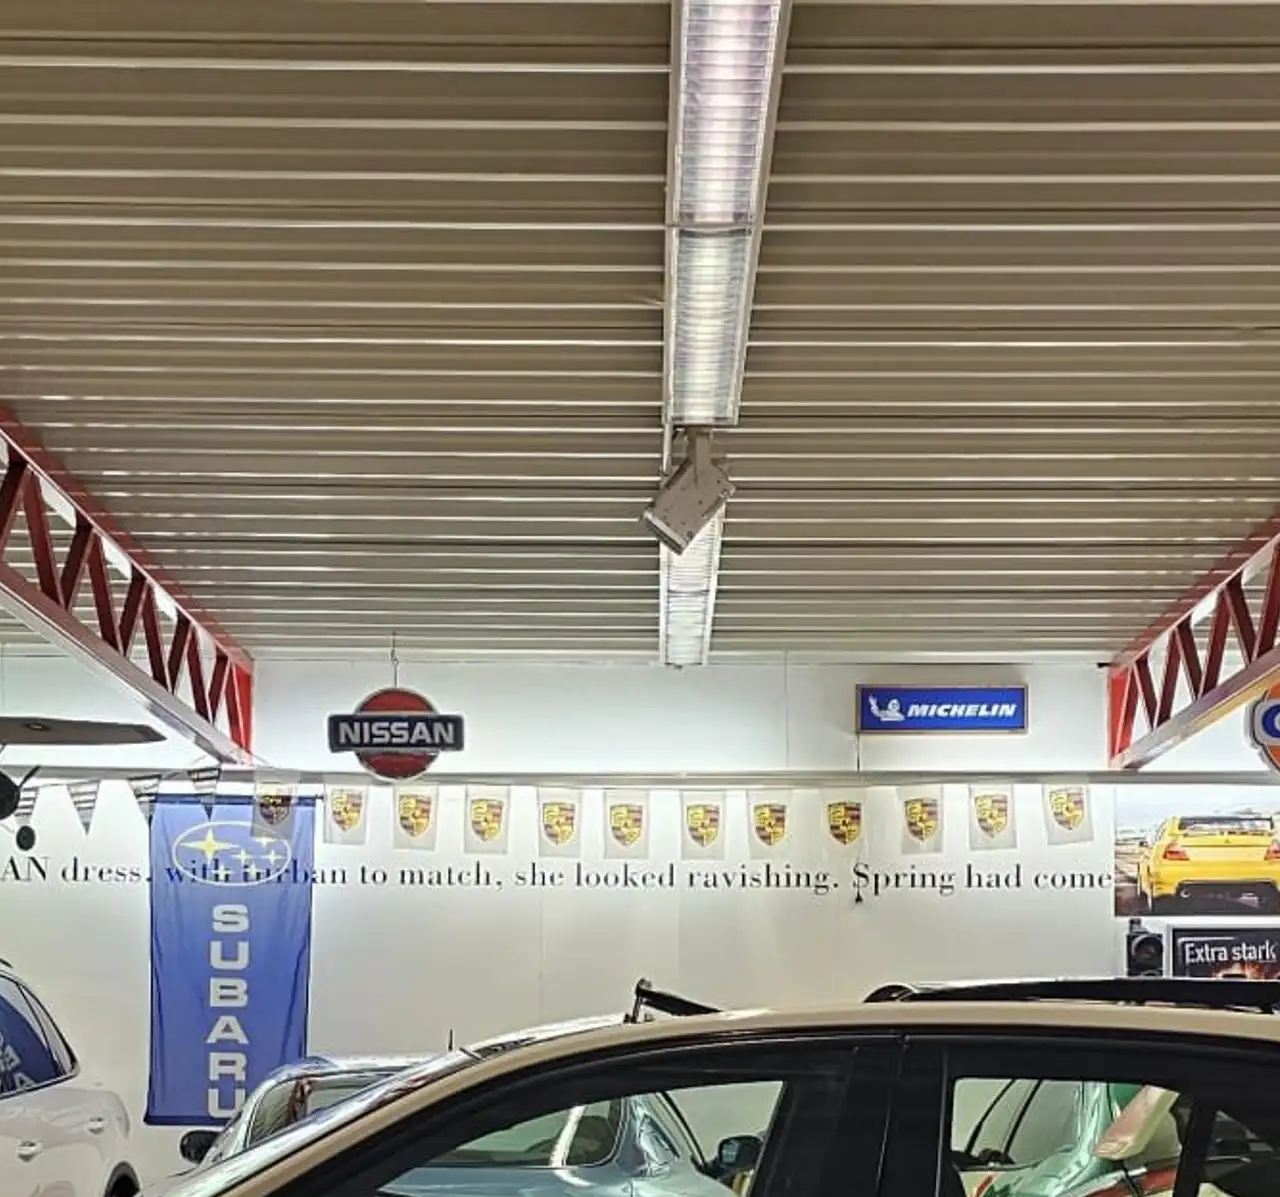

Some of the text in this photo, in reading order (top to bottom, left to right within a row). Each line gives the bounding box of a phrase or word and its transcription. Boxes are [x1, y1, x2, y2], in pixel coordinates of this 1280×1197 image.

[906, 703, 1017, 718] MICHELIN
[339, 721, 455, 744] NISSAN
[359, 864, 388, 885] to
[399, 860, 503, 890] match,
[515, 862, 564, 887] she
[575, 862, 675, 888] looked
[688, 863, 839, 895] ravishing.
[852, 861, 956, 896] Spring
[966, 863, 1022, 889] had
[1033, 869, 1113, 889] come
[1185, 940, 1277, 962] Extra stark
[206, 904, 250, 1118] SUBARU
